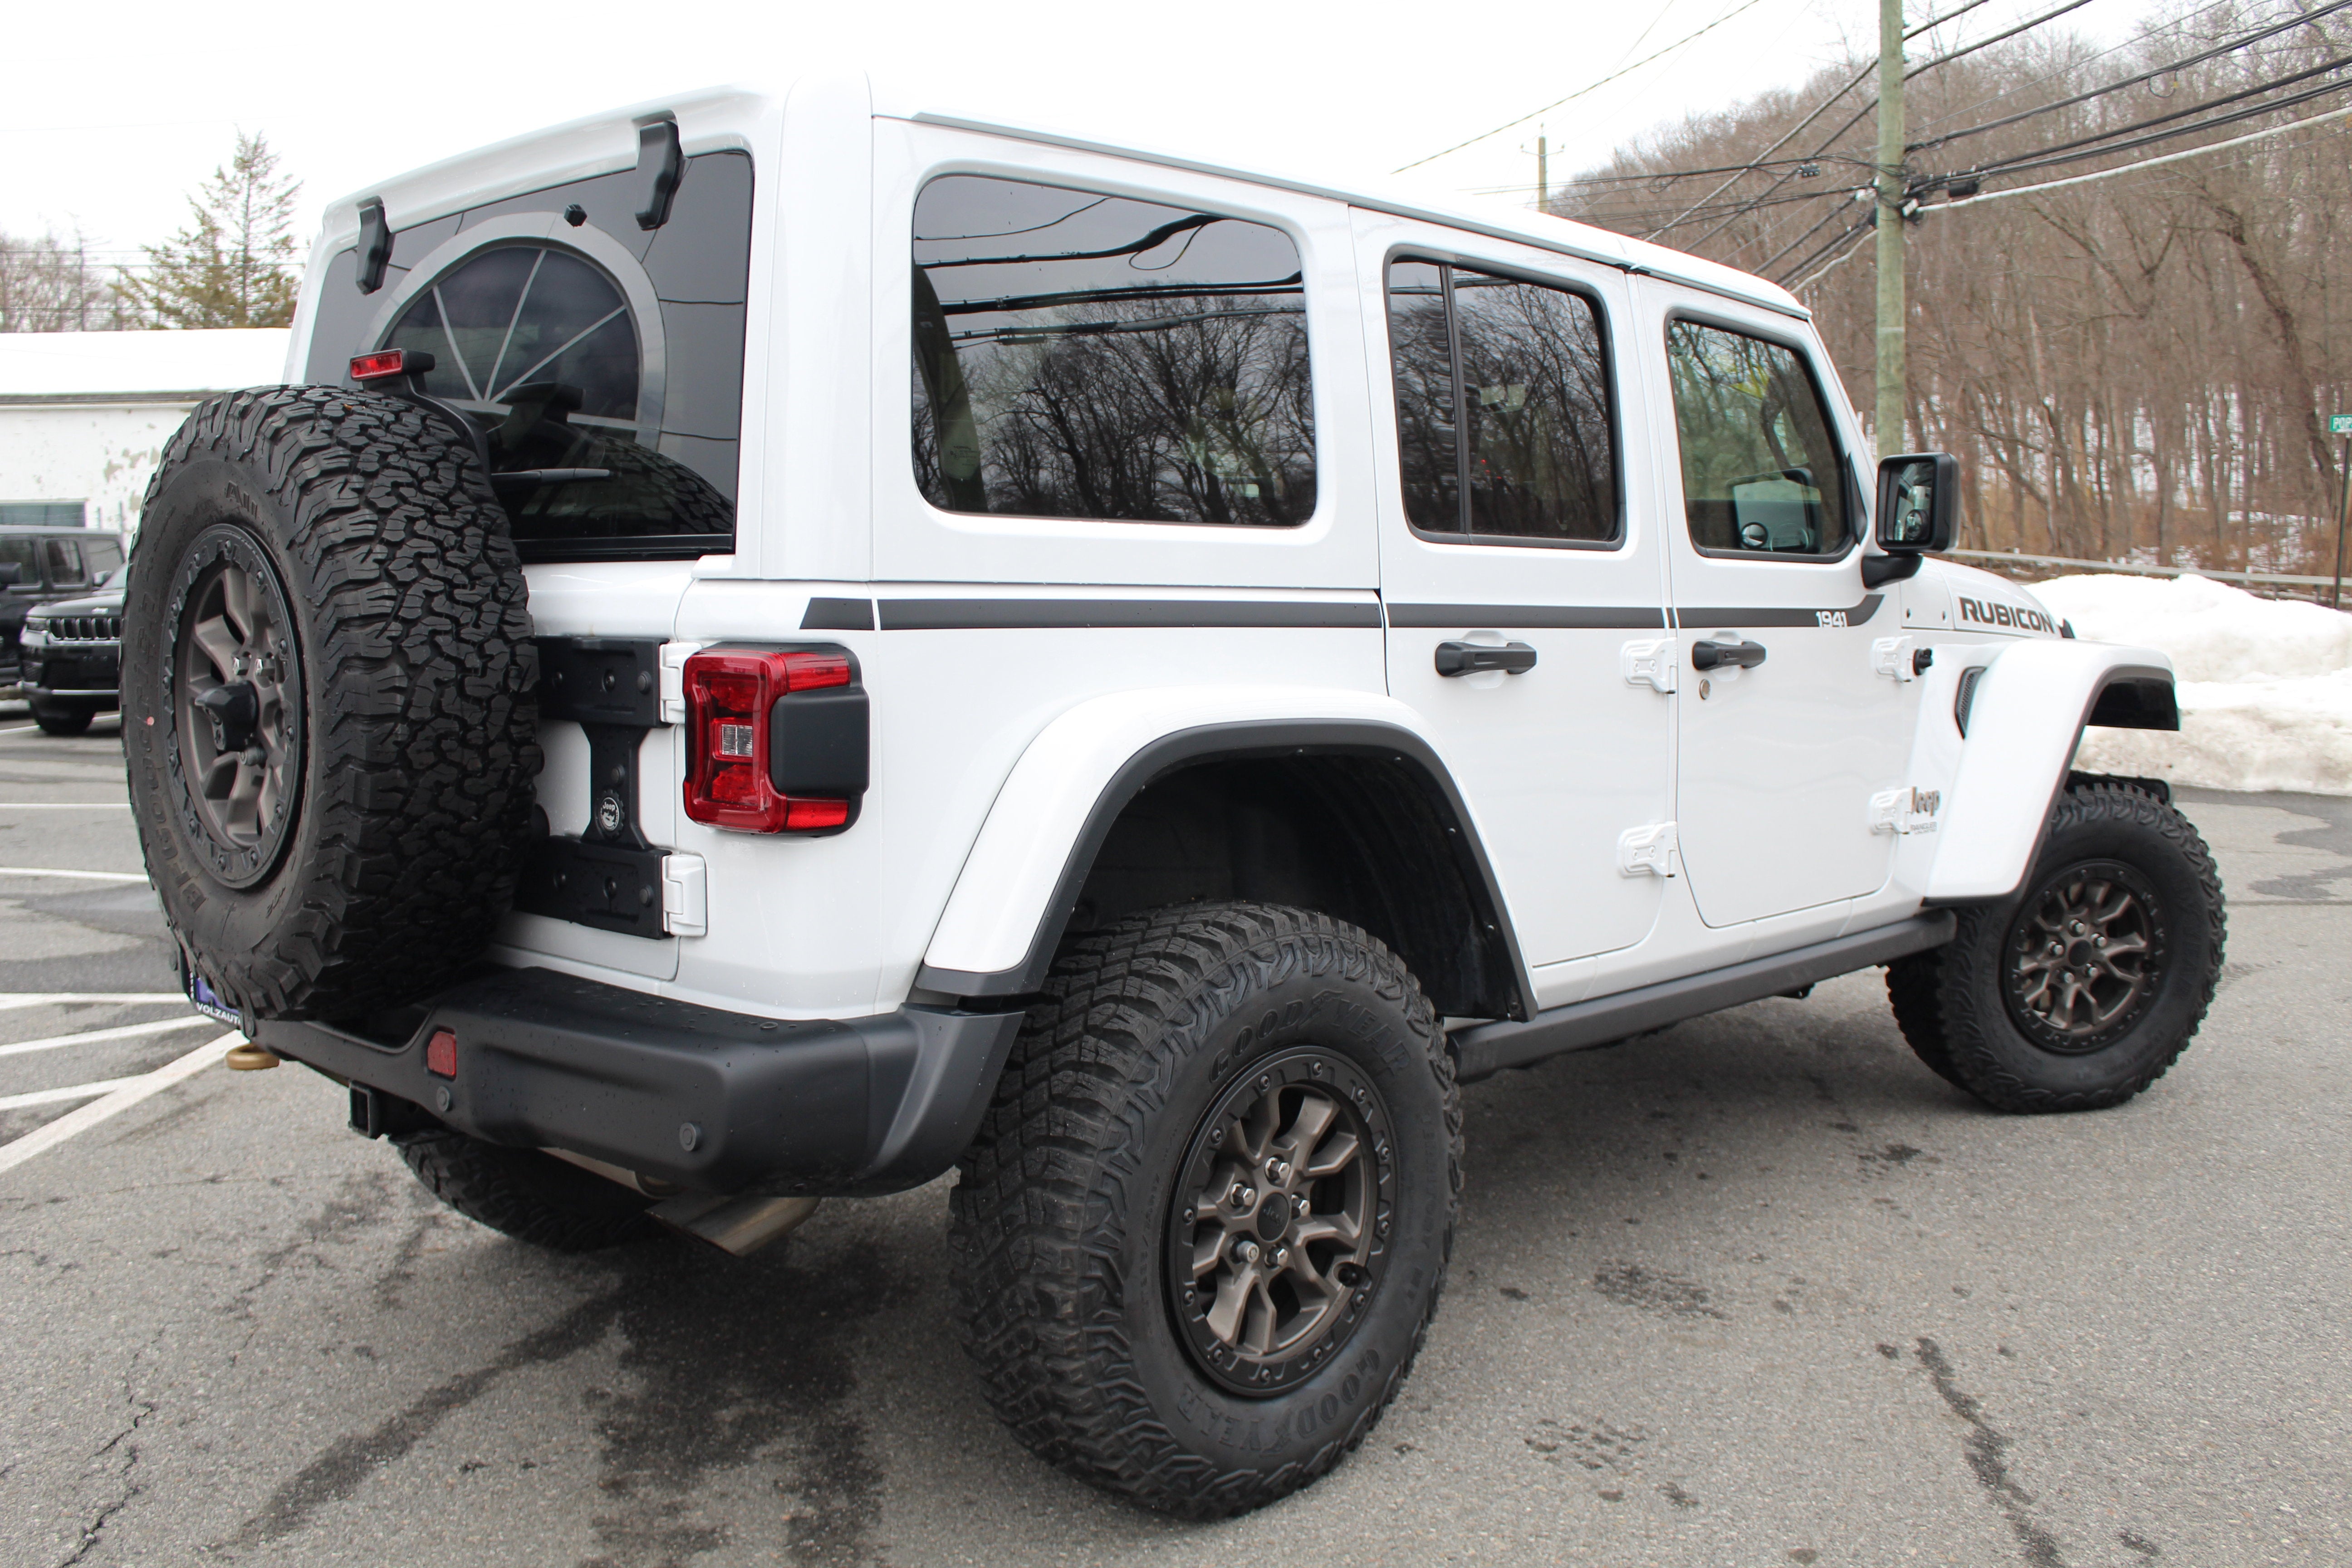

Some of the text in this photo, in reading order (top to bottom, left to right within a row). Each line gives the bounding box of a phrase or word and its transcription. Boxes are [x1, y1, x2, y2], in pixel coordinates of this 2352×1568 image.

[2333, 417, 2352, 429] POP
[1815, 611, 1847, 628] 1941
[1959, 597, 2056, 634] RUBICON
[1910, 785, 1941, 817] Jeep
